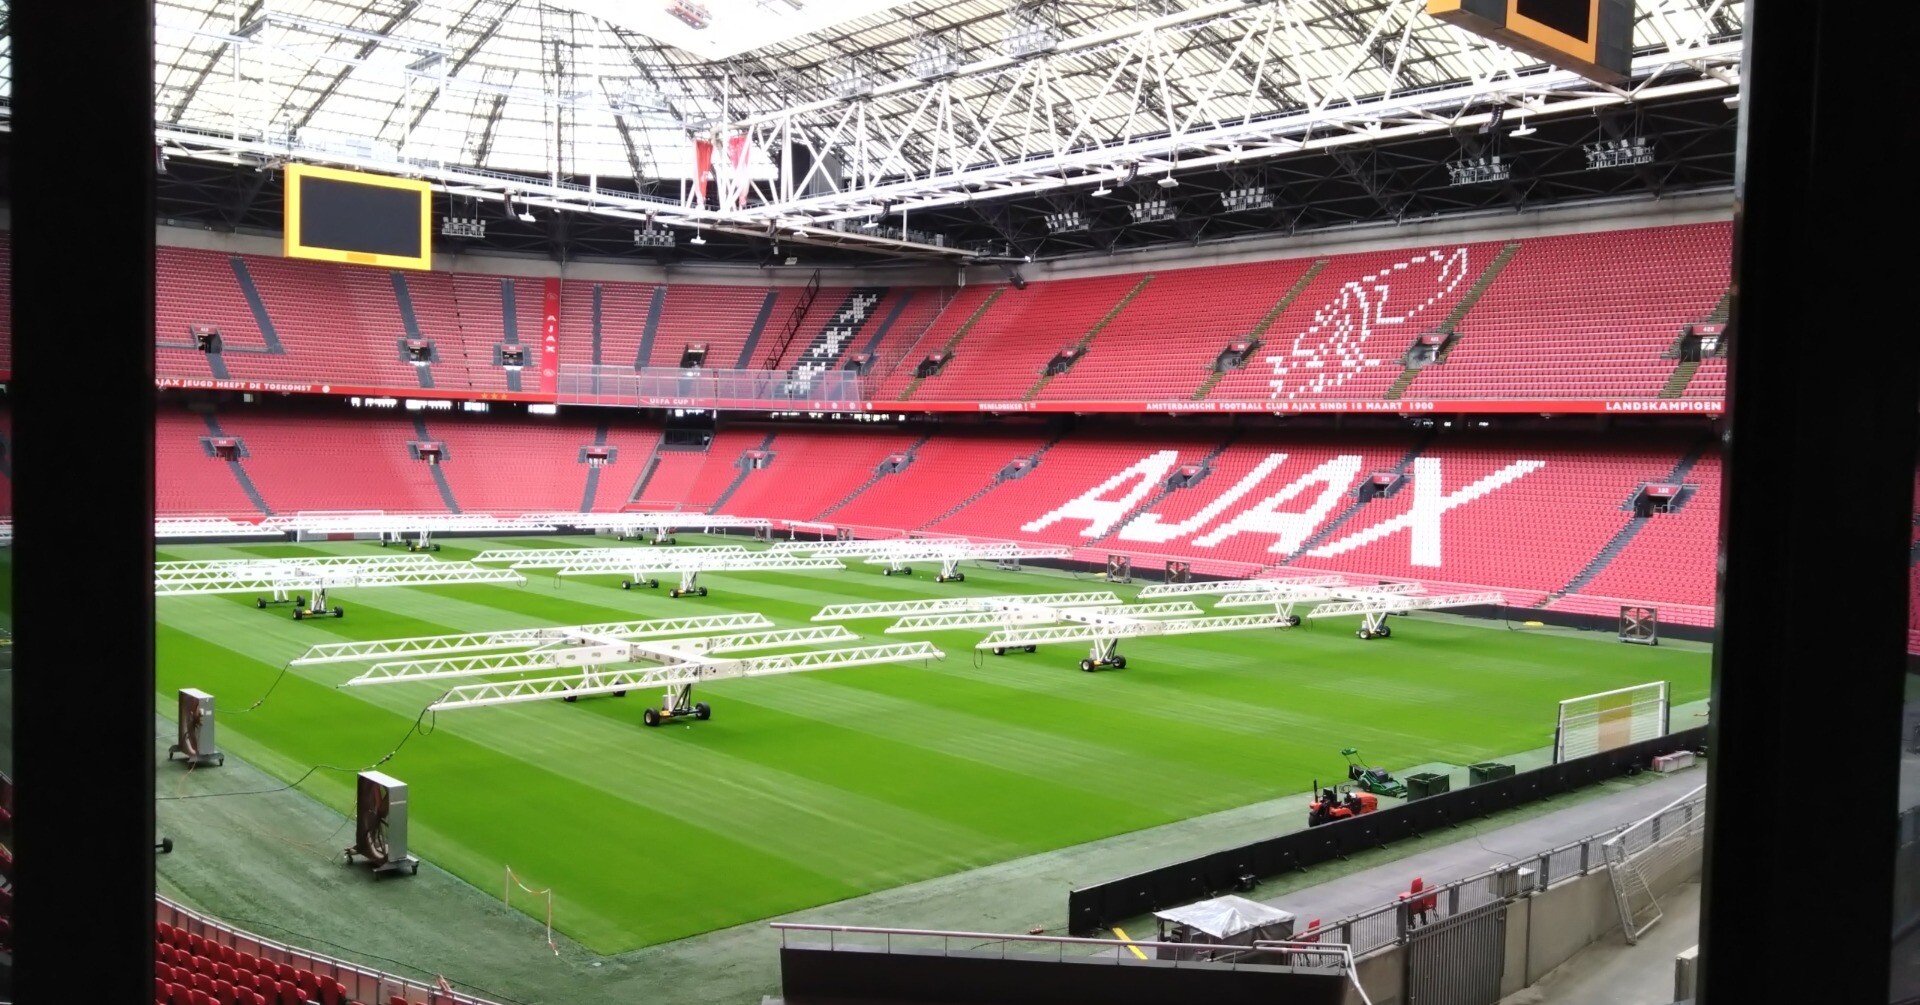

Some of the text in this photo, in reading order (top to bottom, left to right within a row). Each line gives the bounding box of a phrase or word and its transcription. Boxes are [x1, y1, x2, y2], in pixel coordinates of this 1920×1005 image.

[545, 315, 556, 353] AJAX
[182, 379, 213, 388] JEUGD
[216, 381, 246, 389] HEEFT
[250, 382, 261, 390] DE
[264, 383, 312, 391] TOEKOMST
[1146, 402, 1434, 411] AMSTERDAMSCHE FOOTBALL CLUB AJAX SINDS 18 MAART 1900
[1605, 401, 1722, 411] LANDSKAMPIOEN
[1021, 450, 1546, 567] AJAX
